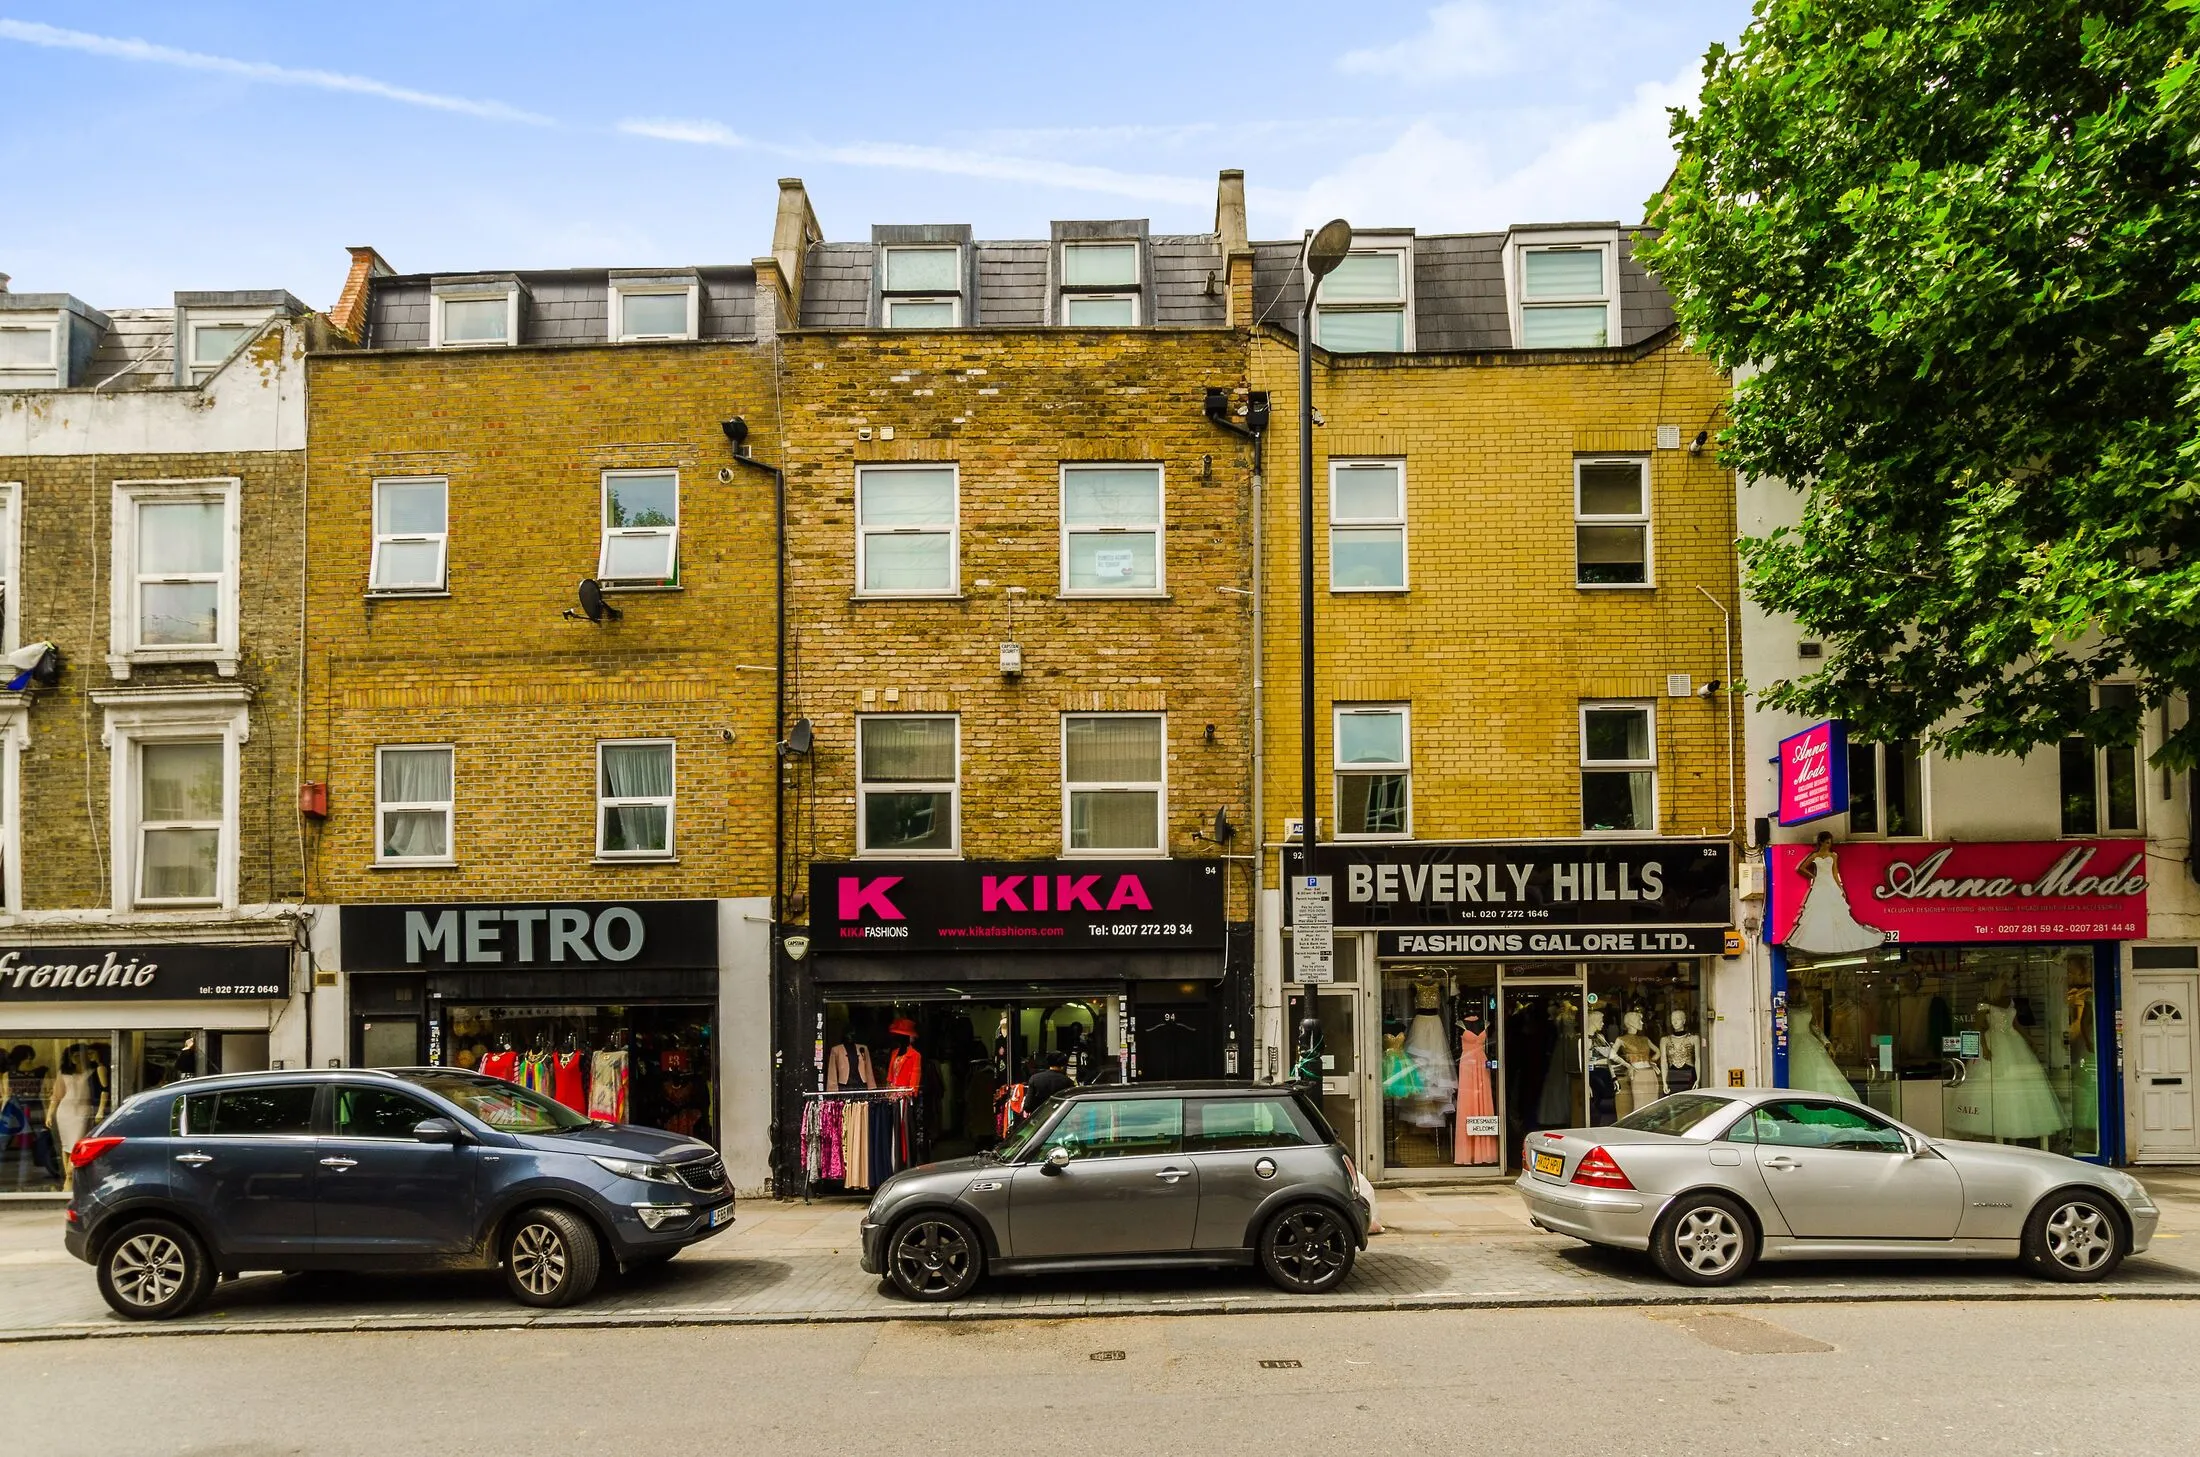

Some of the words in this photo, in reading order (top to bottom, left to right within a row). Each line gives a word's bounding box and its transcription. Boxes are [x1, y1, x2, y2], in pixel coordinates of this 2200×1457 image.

[1792, 735, 1827, 763] Anna
[1794, 756, 1825, 785] Mode
[1703, 848, 1717, 856] 92a
[1205, 867, 1216, 875] 94
[1875, 848, 2016, 899] Anna
[2022, 847, 2149, 898] Mode
[1349, 864, 1535, 902] BEVERLY
[1553, 862, 1663, 900] HILLS
[838, 876, 906, 920] K
[982, 874, 1153, 912] KIKA
[1462, 910, 1477, 918] tel.
[1480, 910, 1496, 918] 020
[1527, 910, 1549, 918] 1646
[405, 907, 645, 963] METRO
[938, 926, 1064, 938] www.kikafashions.com
[1088, 925, 1109, 936] Tel:
[1112, 925, 1137, 935] 0207
[1140, 925, 1160, 935] 272
[1163, 924, 1176, 935] 29
[1179, 924, 1193, 935] 34
[1885, 932, 1898, 941] 92
[1399, 935, 1522, 952] FASHIONS
[1530, 934, 1635, 952] GALORE
[1641, 933, 1695, 950] LTD.
[1911, 951, 1970, 972] SALE
[200, 986, 213, 994] tel:
[215, 986, 232, 994] 020
[234, 985, 255, 994] 7272
[258, 985, 278, 993] 0649
[1164, 1013, 1175, 1021] 94
[1953, 1014, 1976, 1023] SALE
[1730, 1071, 1742, 1086] H
[1956, 1105, 1980, 1115] SALE
